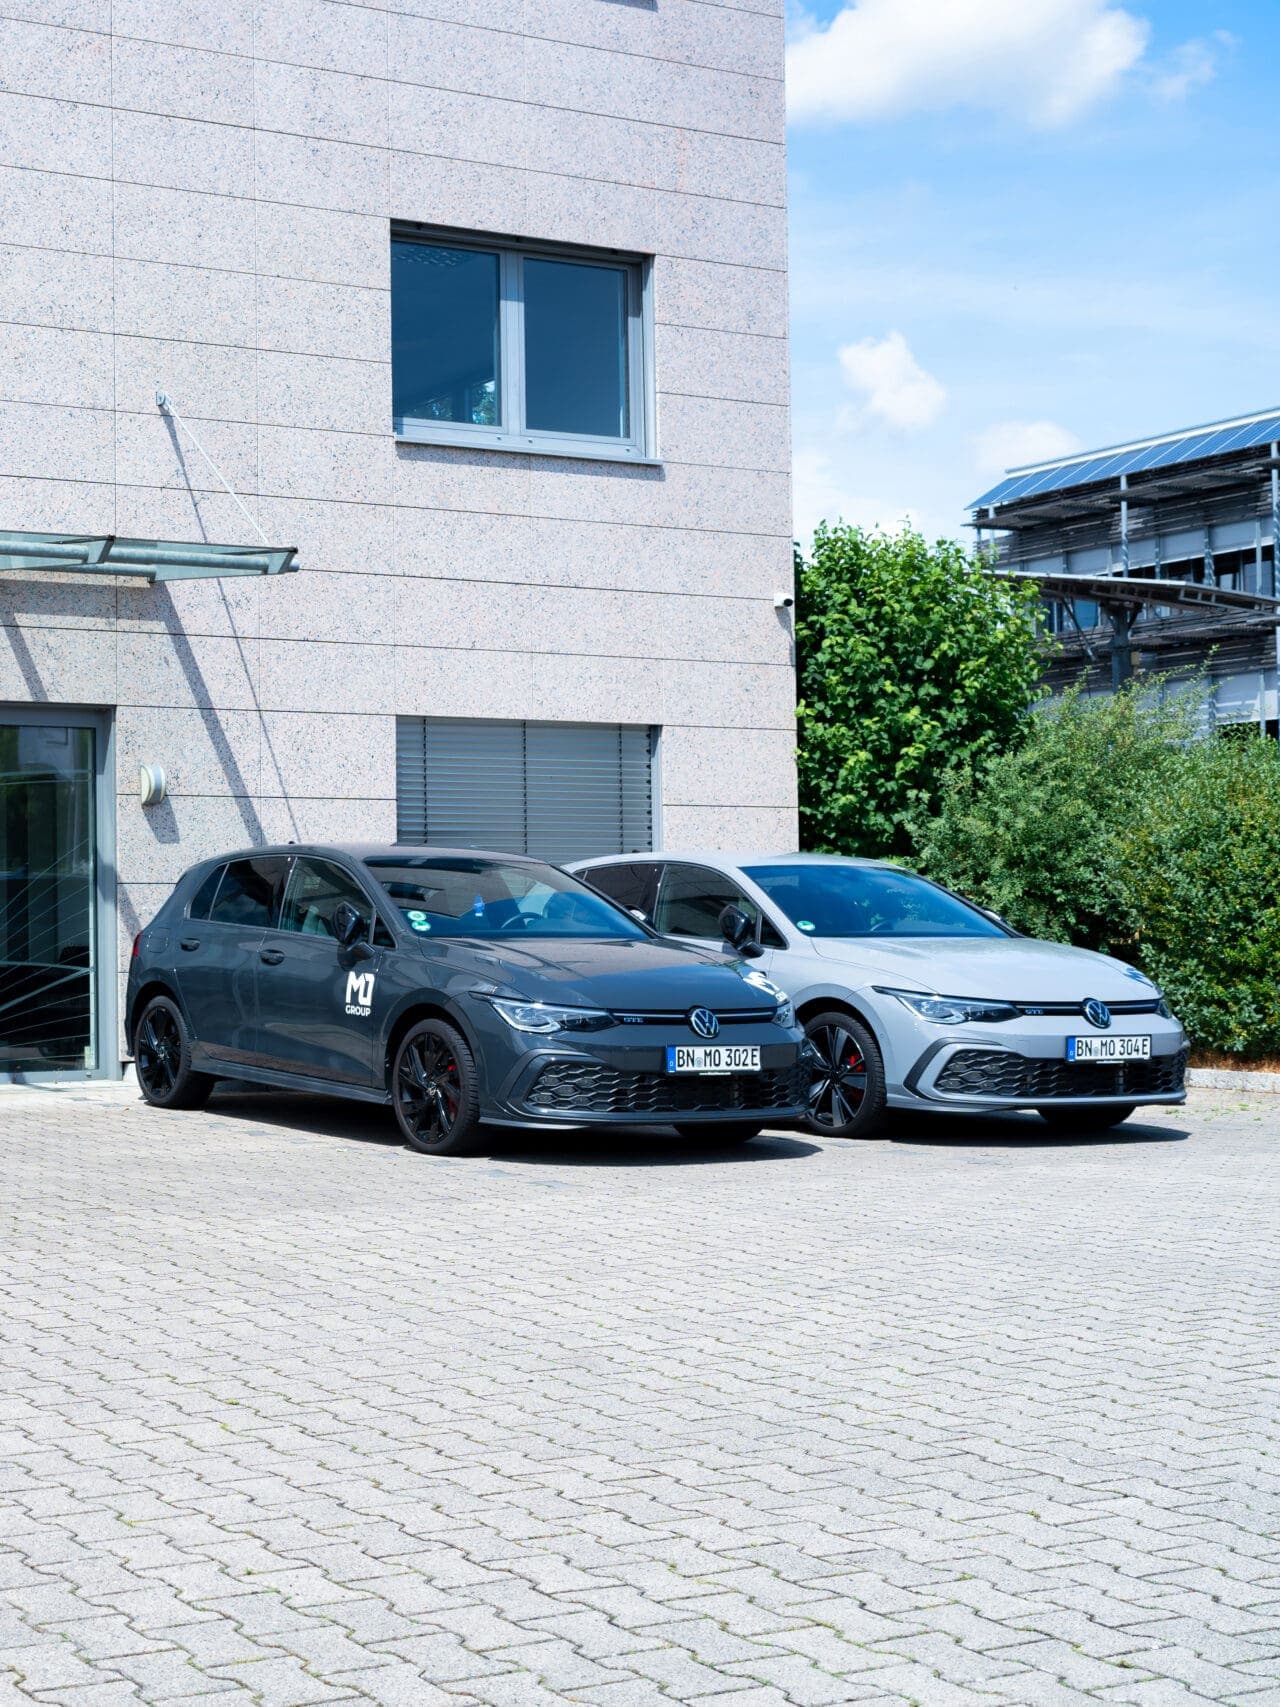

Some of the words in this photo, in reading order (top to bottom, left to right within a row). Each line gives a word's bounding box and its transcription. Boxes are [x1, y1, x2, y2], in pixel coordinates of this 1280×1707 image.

[345, 1004, 371, 1017] GROUP
[1076, 1040, 1092, 1057] BN
[1100, 1039, 1116, 1056] MO
[1120, 1038, 1149, 1056] 304E
[677, 1049, 695, 1067] BN
[703, 1049, 721, 1067] MO
[725, 1048, 759, 1067] 302E
